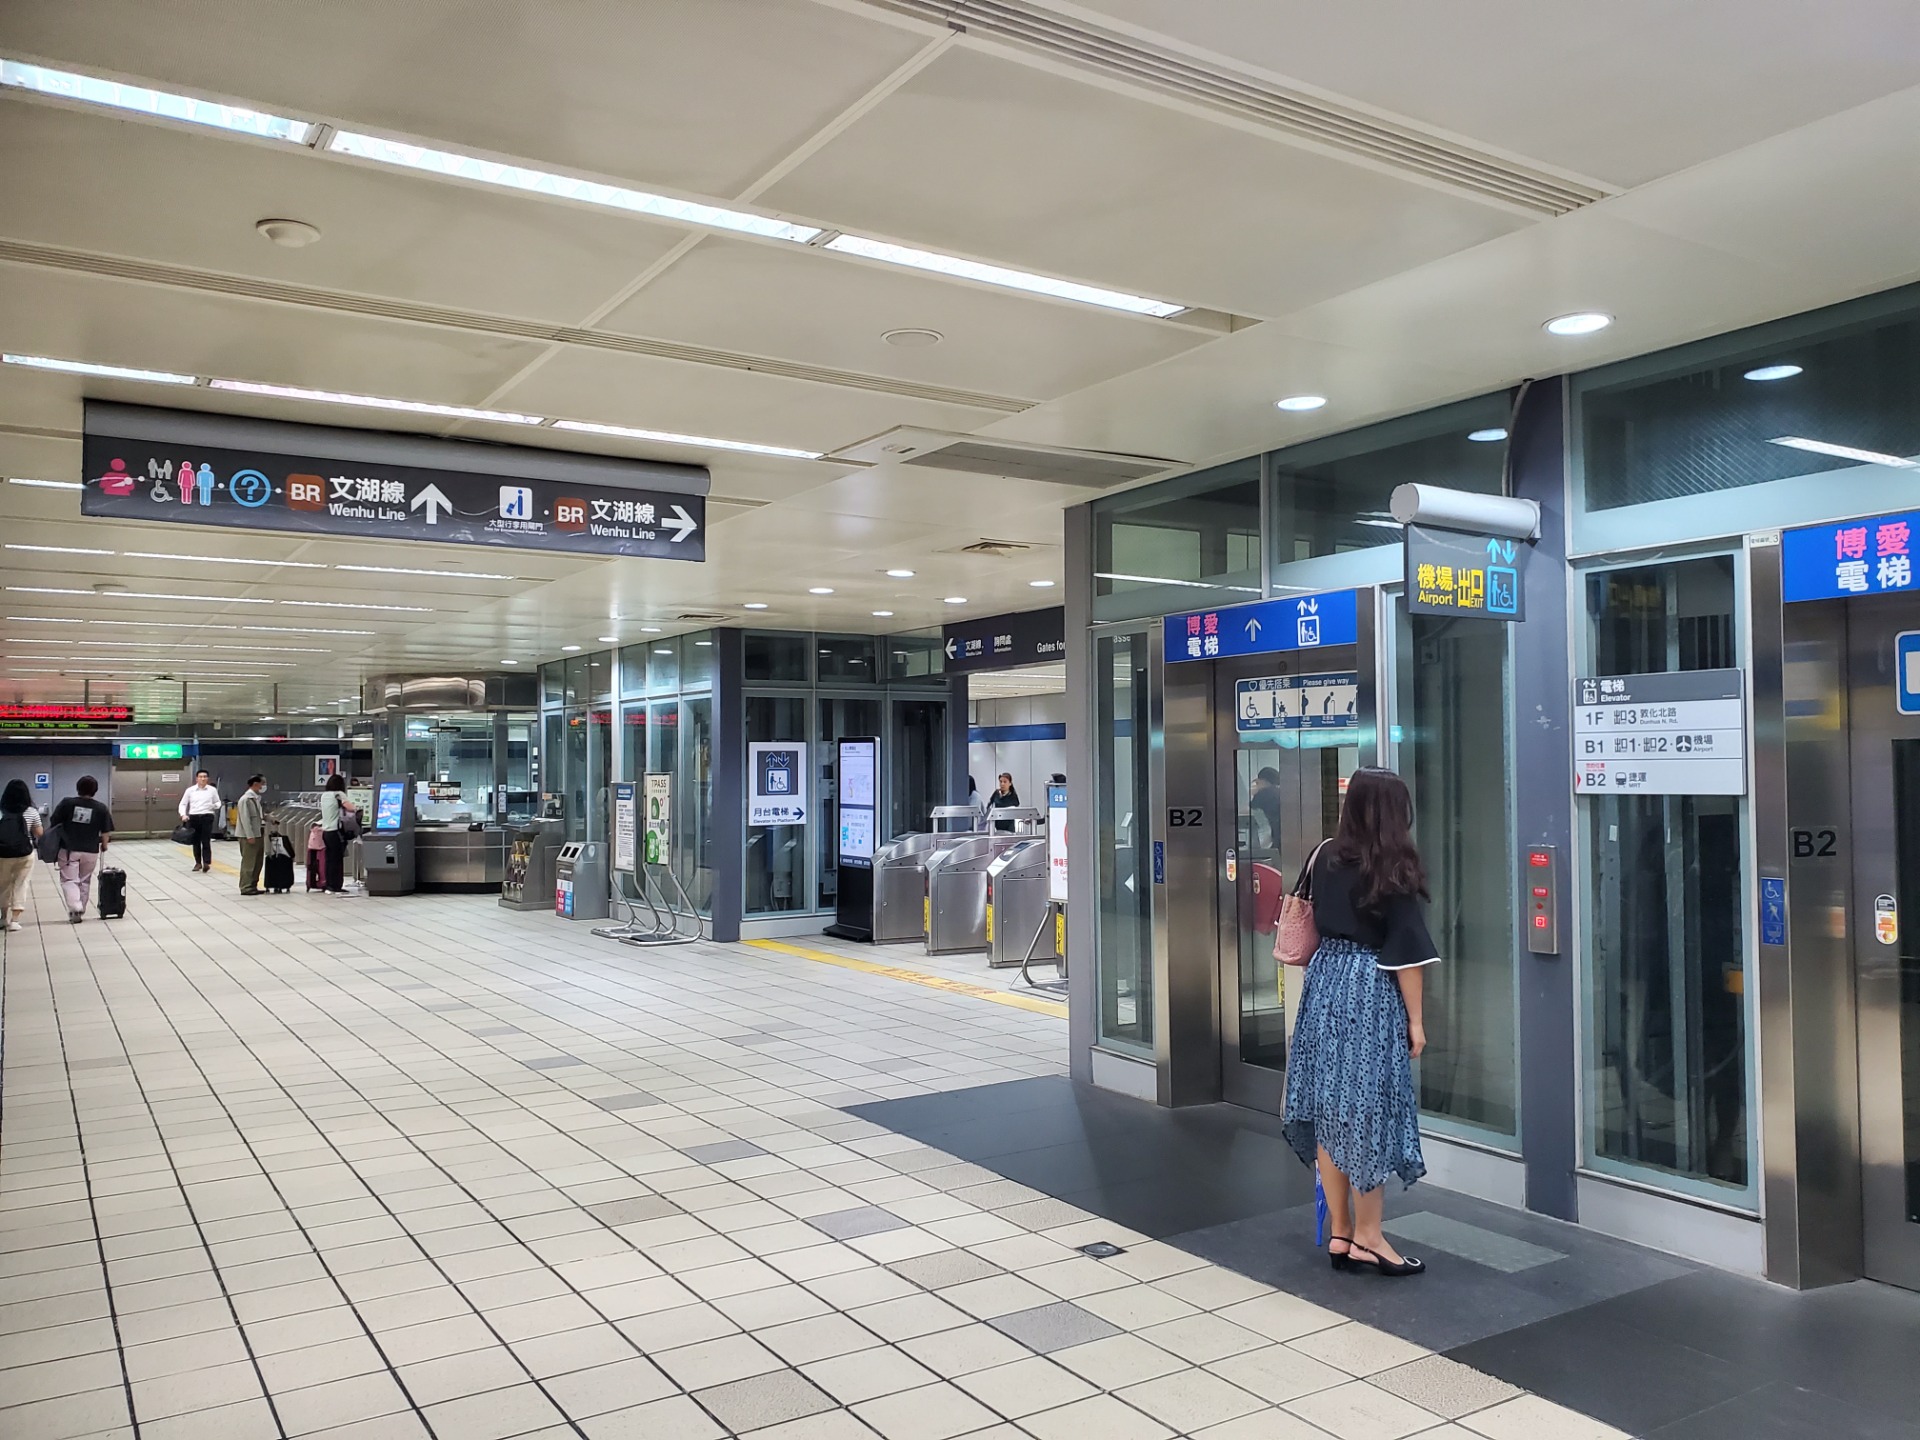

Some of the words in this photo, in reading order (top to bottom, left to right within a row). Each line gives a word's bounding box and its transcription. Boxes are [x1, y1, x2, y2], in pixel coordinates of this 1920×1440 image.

[291, 483, 321, 502] BR
[329, 476, 406, 503] 文湖線
[328, 503, 375, 518] Wenhu
[378, 507, 406, 521] Line
[557, 506, 584, 524] BR
[590, 499, 656, 525] 文湖線
[590, 524, 630, 538] Wenhu
[632, 526, 656, 540] Line
[1834, 521, 1911, 560] 博愛
[1835, 556, 1911, 592] 電梯
[1417, 563, 1453, 591] 機場
[1457, 568, 1484, 608] 出口
[1418, 590, 1453, 607] Airport
[1470, 598, 1484, 608] EXIT
[1187, 613, 1219, 635] 博愛
[1037, 642, 1055, 653] Gates
[1187, 636, 1219, 657] 電梯
[1323, 679, 1336, 687] give
[1600, 679, 1625, 693] 電梯
[1600, 694, 1631, 702] Elevator
[1585, 712, 1604, 726] 1F
[1585, 740, 1604, 753] B1
[651, 779, 667, 788] TPASS
[1586, 773, 1606, 786] B2
[753, 807, 789, 817] 月台電梯
[1169, 809, 1203, 827] B2
[1794, 830, 1837, 857] B2
